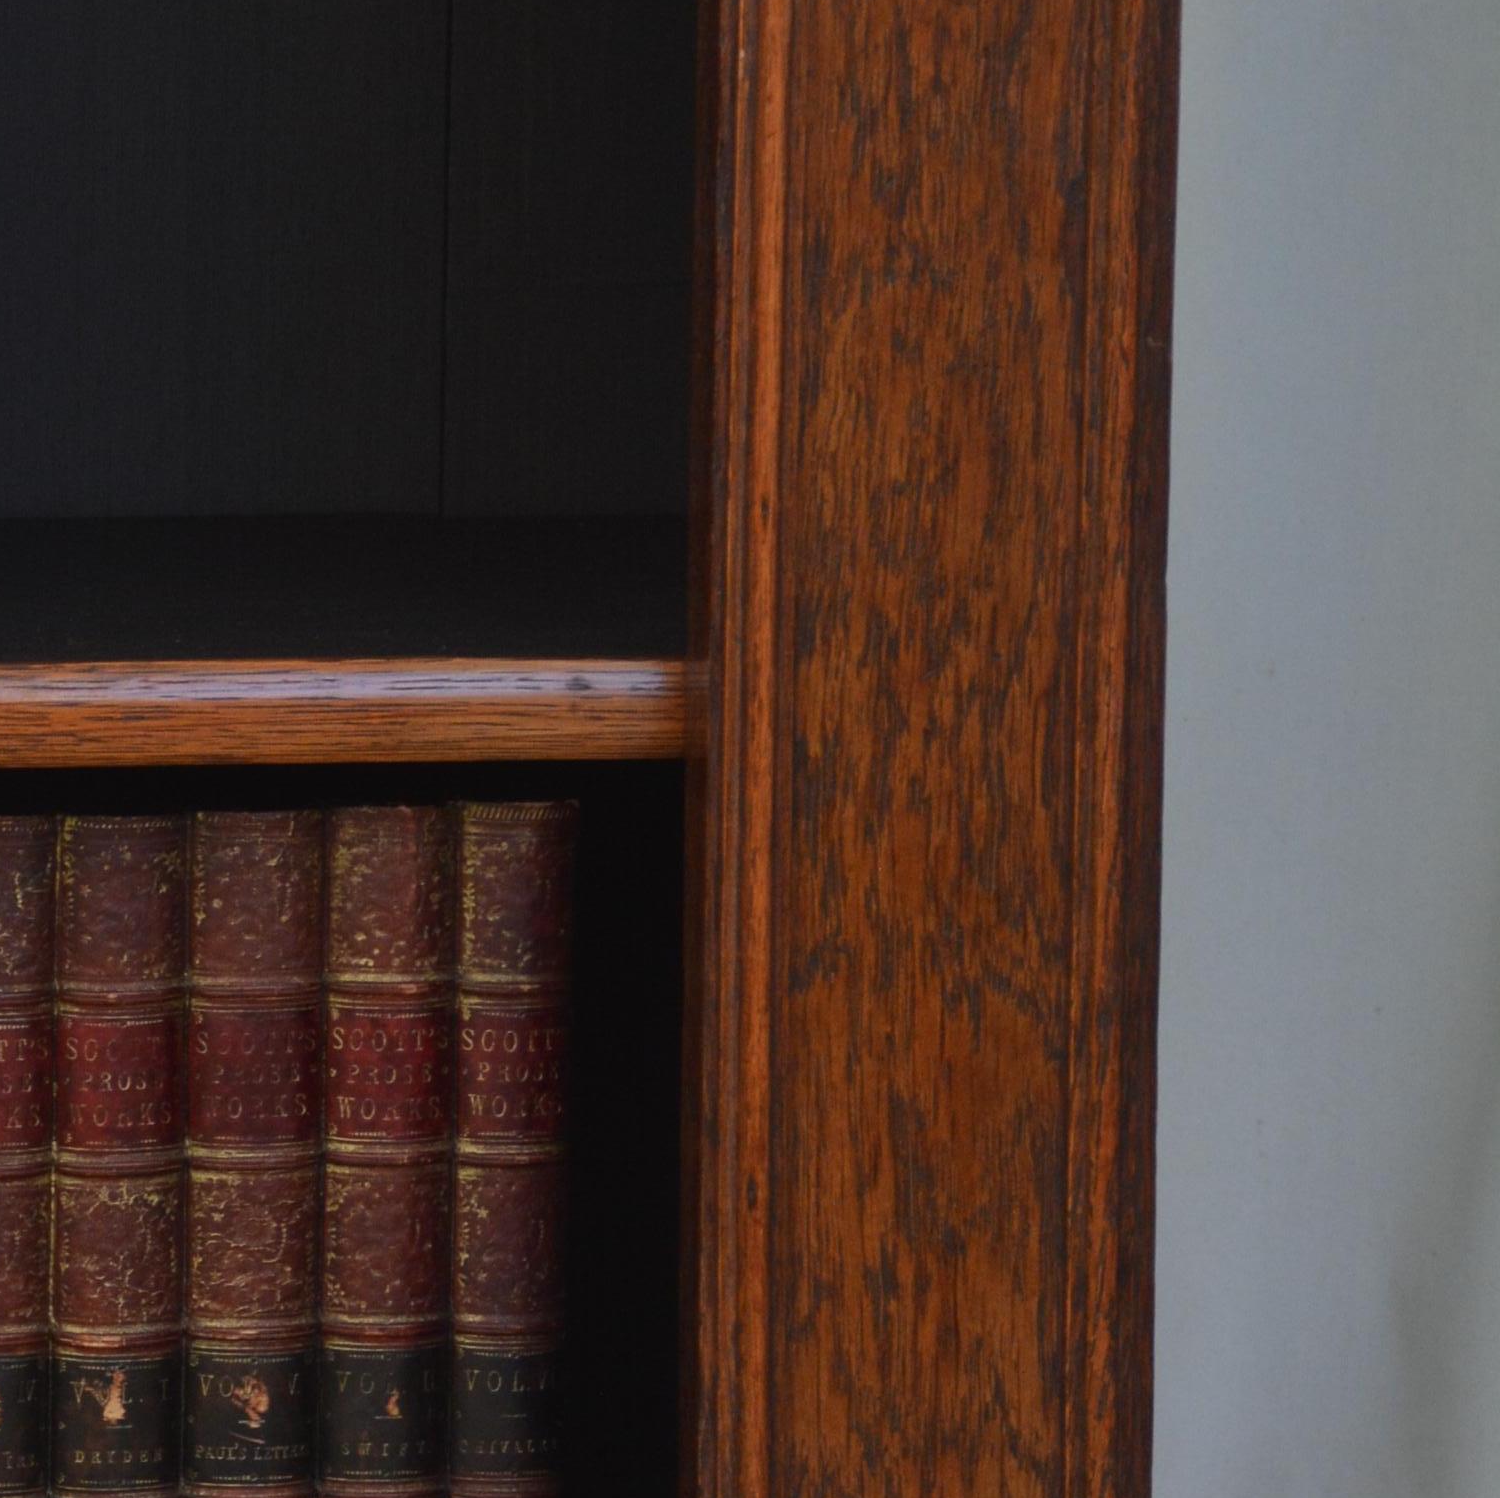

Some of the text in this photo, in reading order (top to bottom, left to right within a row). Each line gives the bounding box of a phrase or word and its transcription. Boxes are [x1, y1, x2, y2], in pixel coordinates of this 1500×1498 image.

[332, 1025, 449, 1053] SCOTT'S
[460, 1027, 564, 1054] SCOTT'
[69, 1380, 144, 1406] VL.
